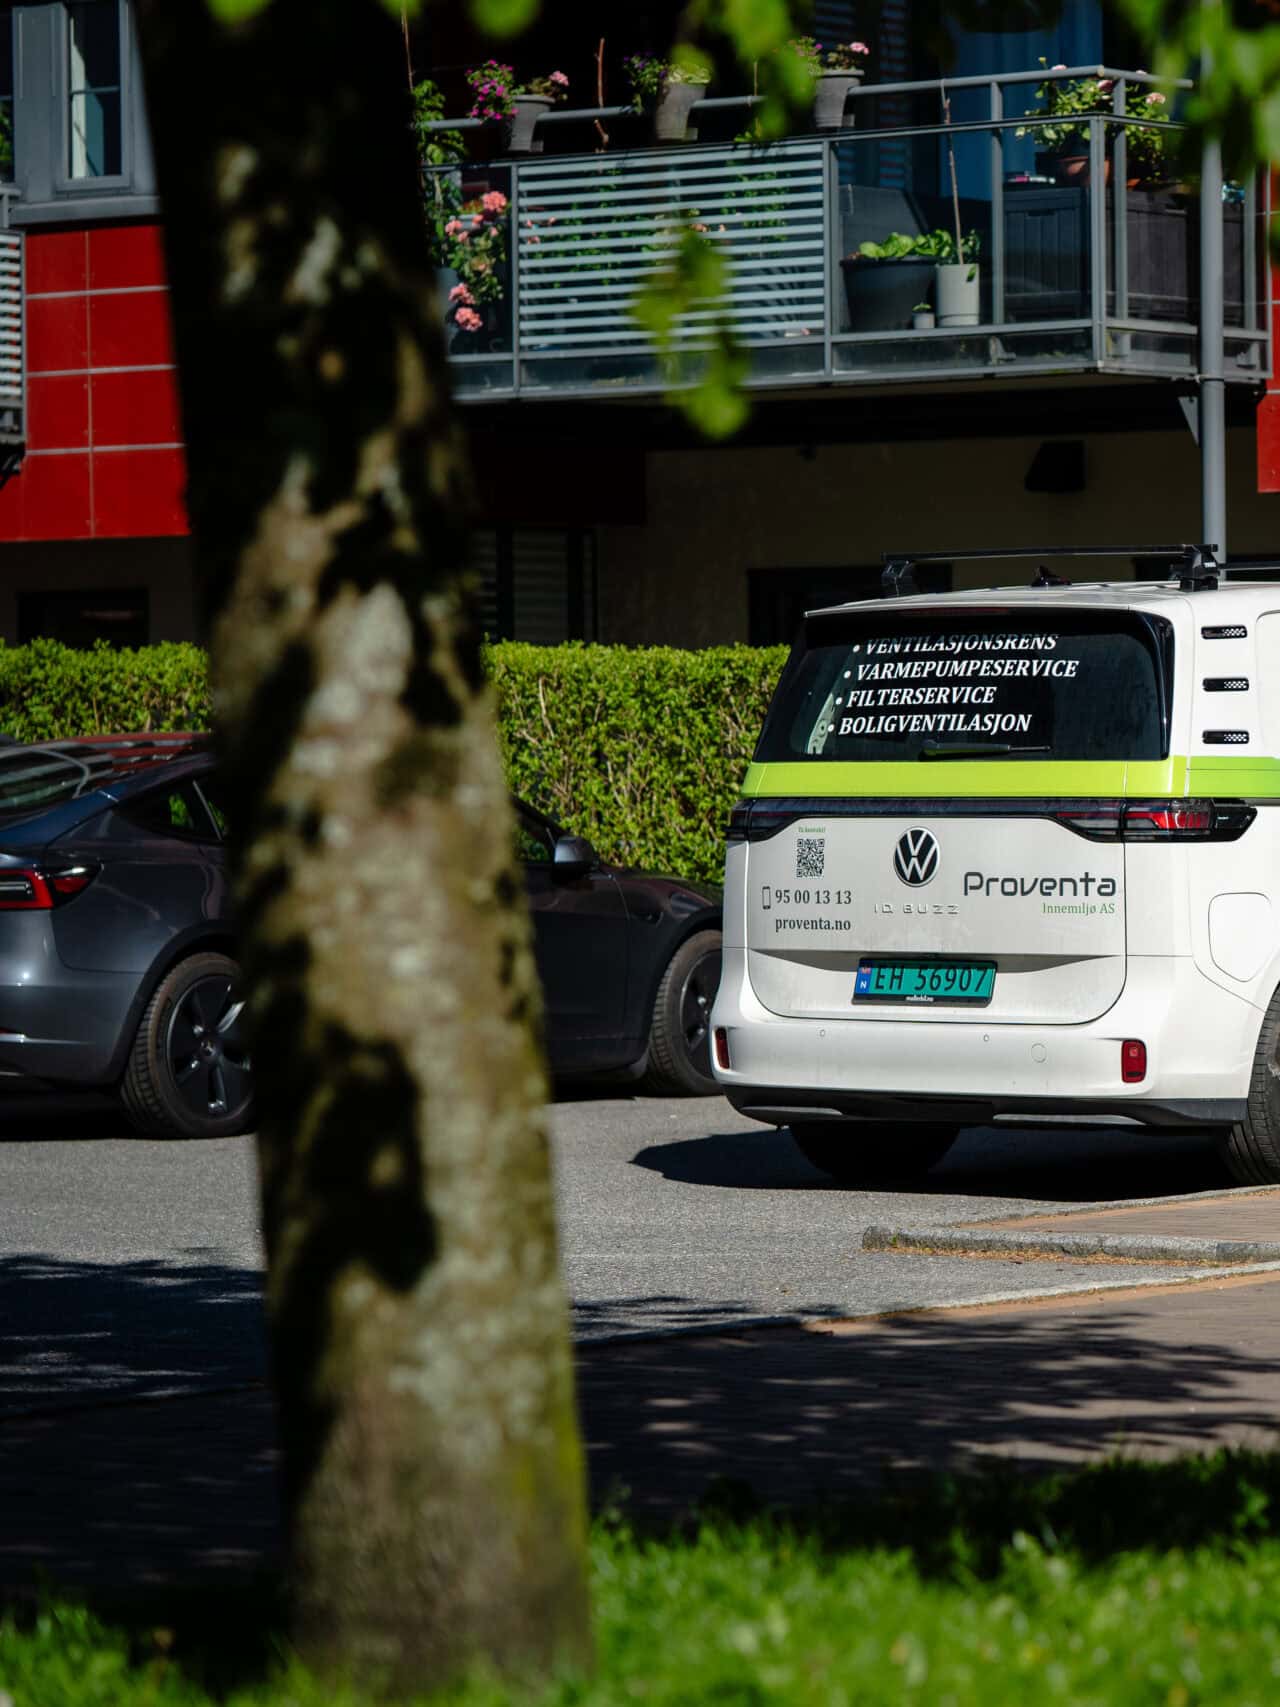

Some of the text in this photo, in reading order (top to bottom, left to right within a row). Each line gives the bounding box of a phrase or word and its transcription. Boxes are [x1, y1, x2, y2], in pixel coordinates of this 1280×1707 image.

[865, 633, 1059, 654] VENTILASJONSRENS
[856, 659, 1080, 681] VARMEPUMPESERVICE
[846, 686, 997, 708] FILTERSERVICE
[838, 714, 1032, 736] BOLIGVENTILASJON
[964, 871, 1116, 896] Proventa
[775, 889, 852, 904] 95 00 13 13
[1042, 902, 1116, 916] Innemiljø AS
[775, 917, 852, 933] proventa.no
[875, 963, 988, 993] EH 56907
